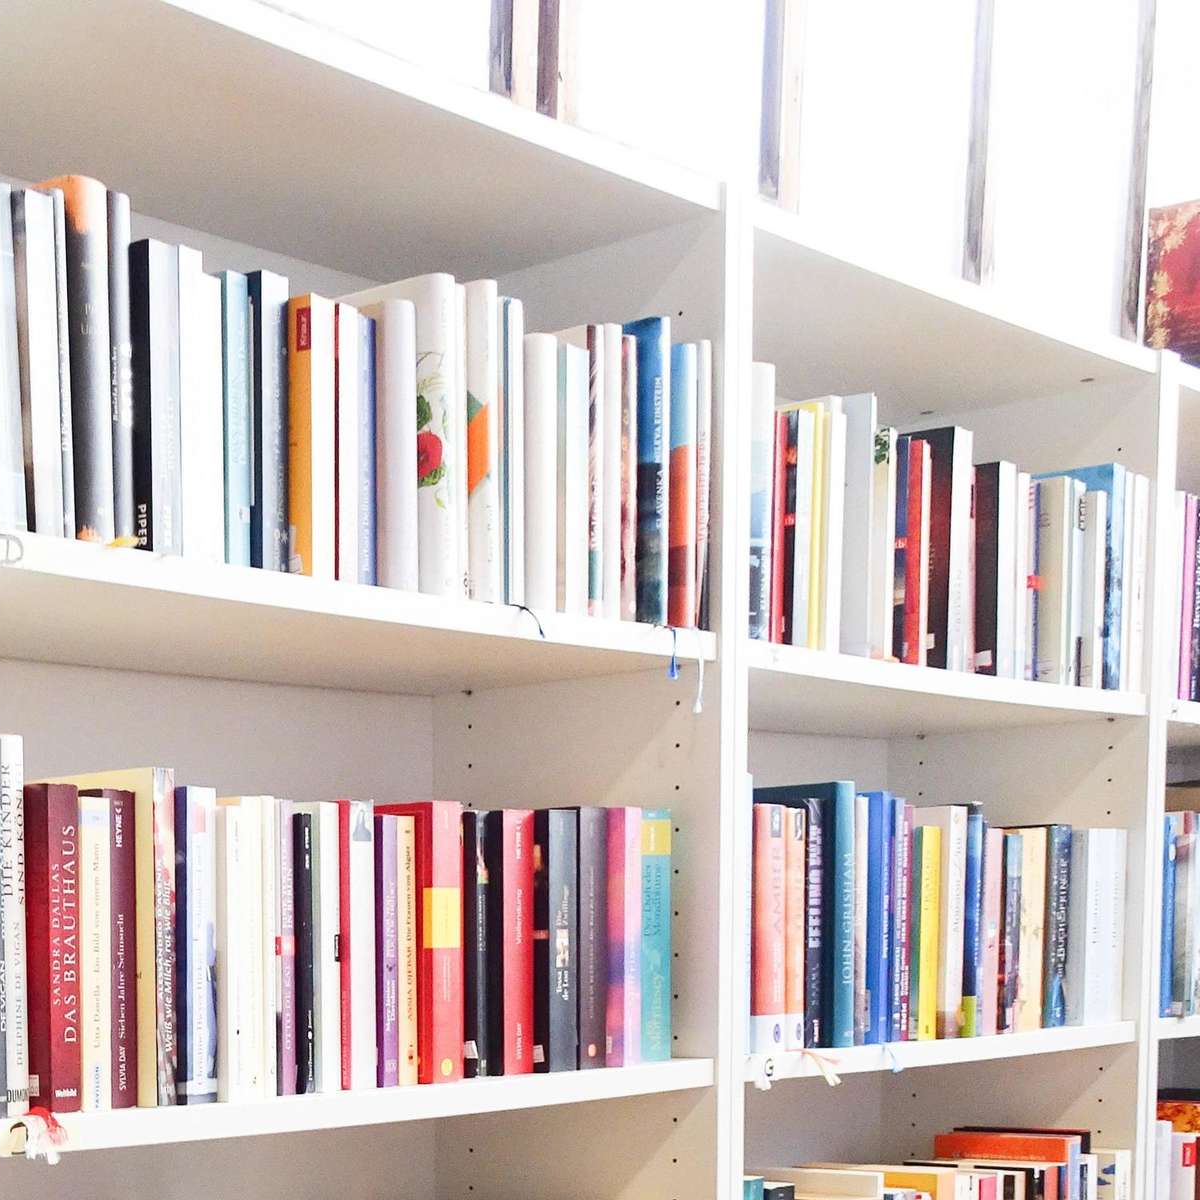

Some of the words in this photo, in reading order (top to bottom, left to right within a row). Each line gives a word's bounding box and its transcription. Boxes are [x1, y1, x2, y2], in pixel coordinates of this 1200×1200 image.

[137, 504, 149, 547] PIPER
[50, 862, 60, 929] DALLAS
[60, 825, 76, 983] BRAUTHAUS
[841, 852, 852, 934] GRISHAM
[50, 936, 61, 1006] SANDRA
[842, 939, 853, 985] JOHN
[62, 993, 77, 1044] DAS
